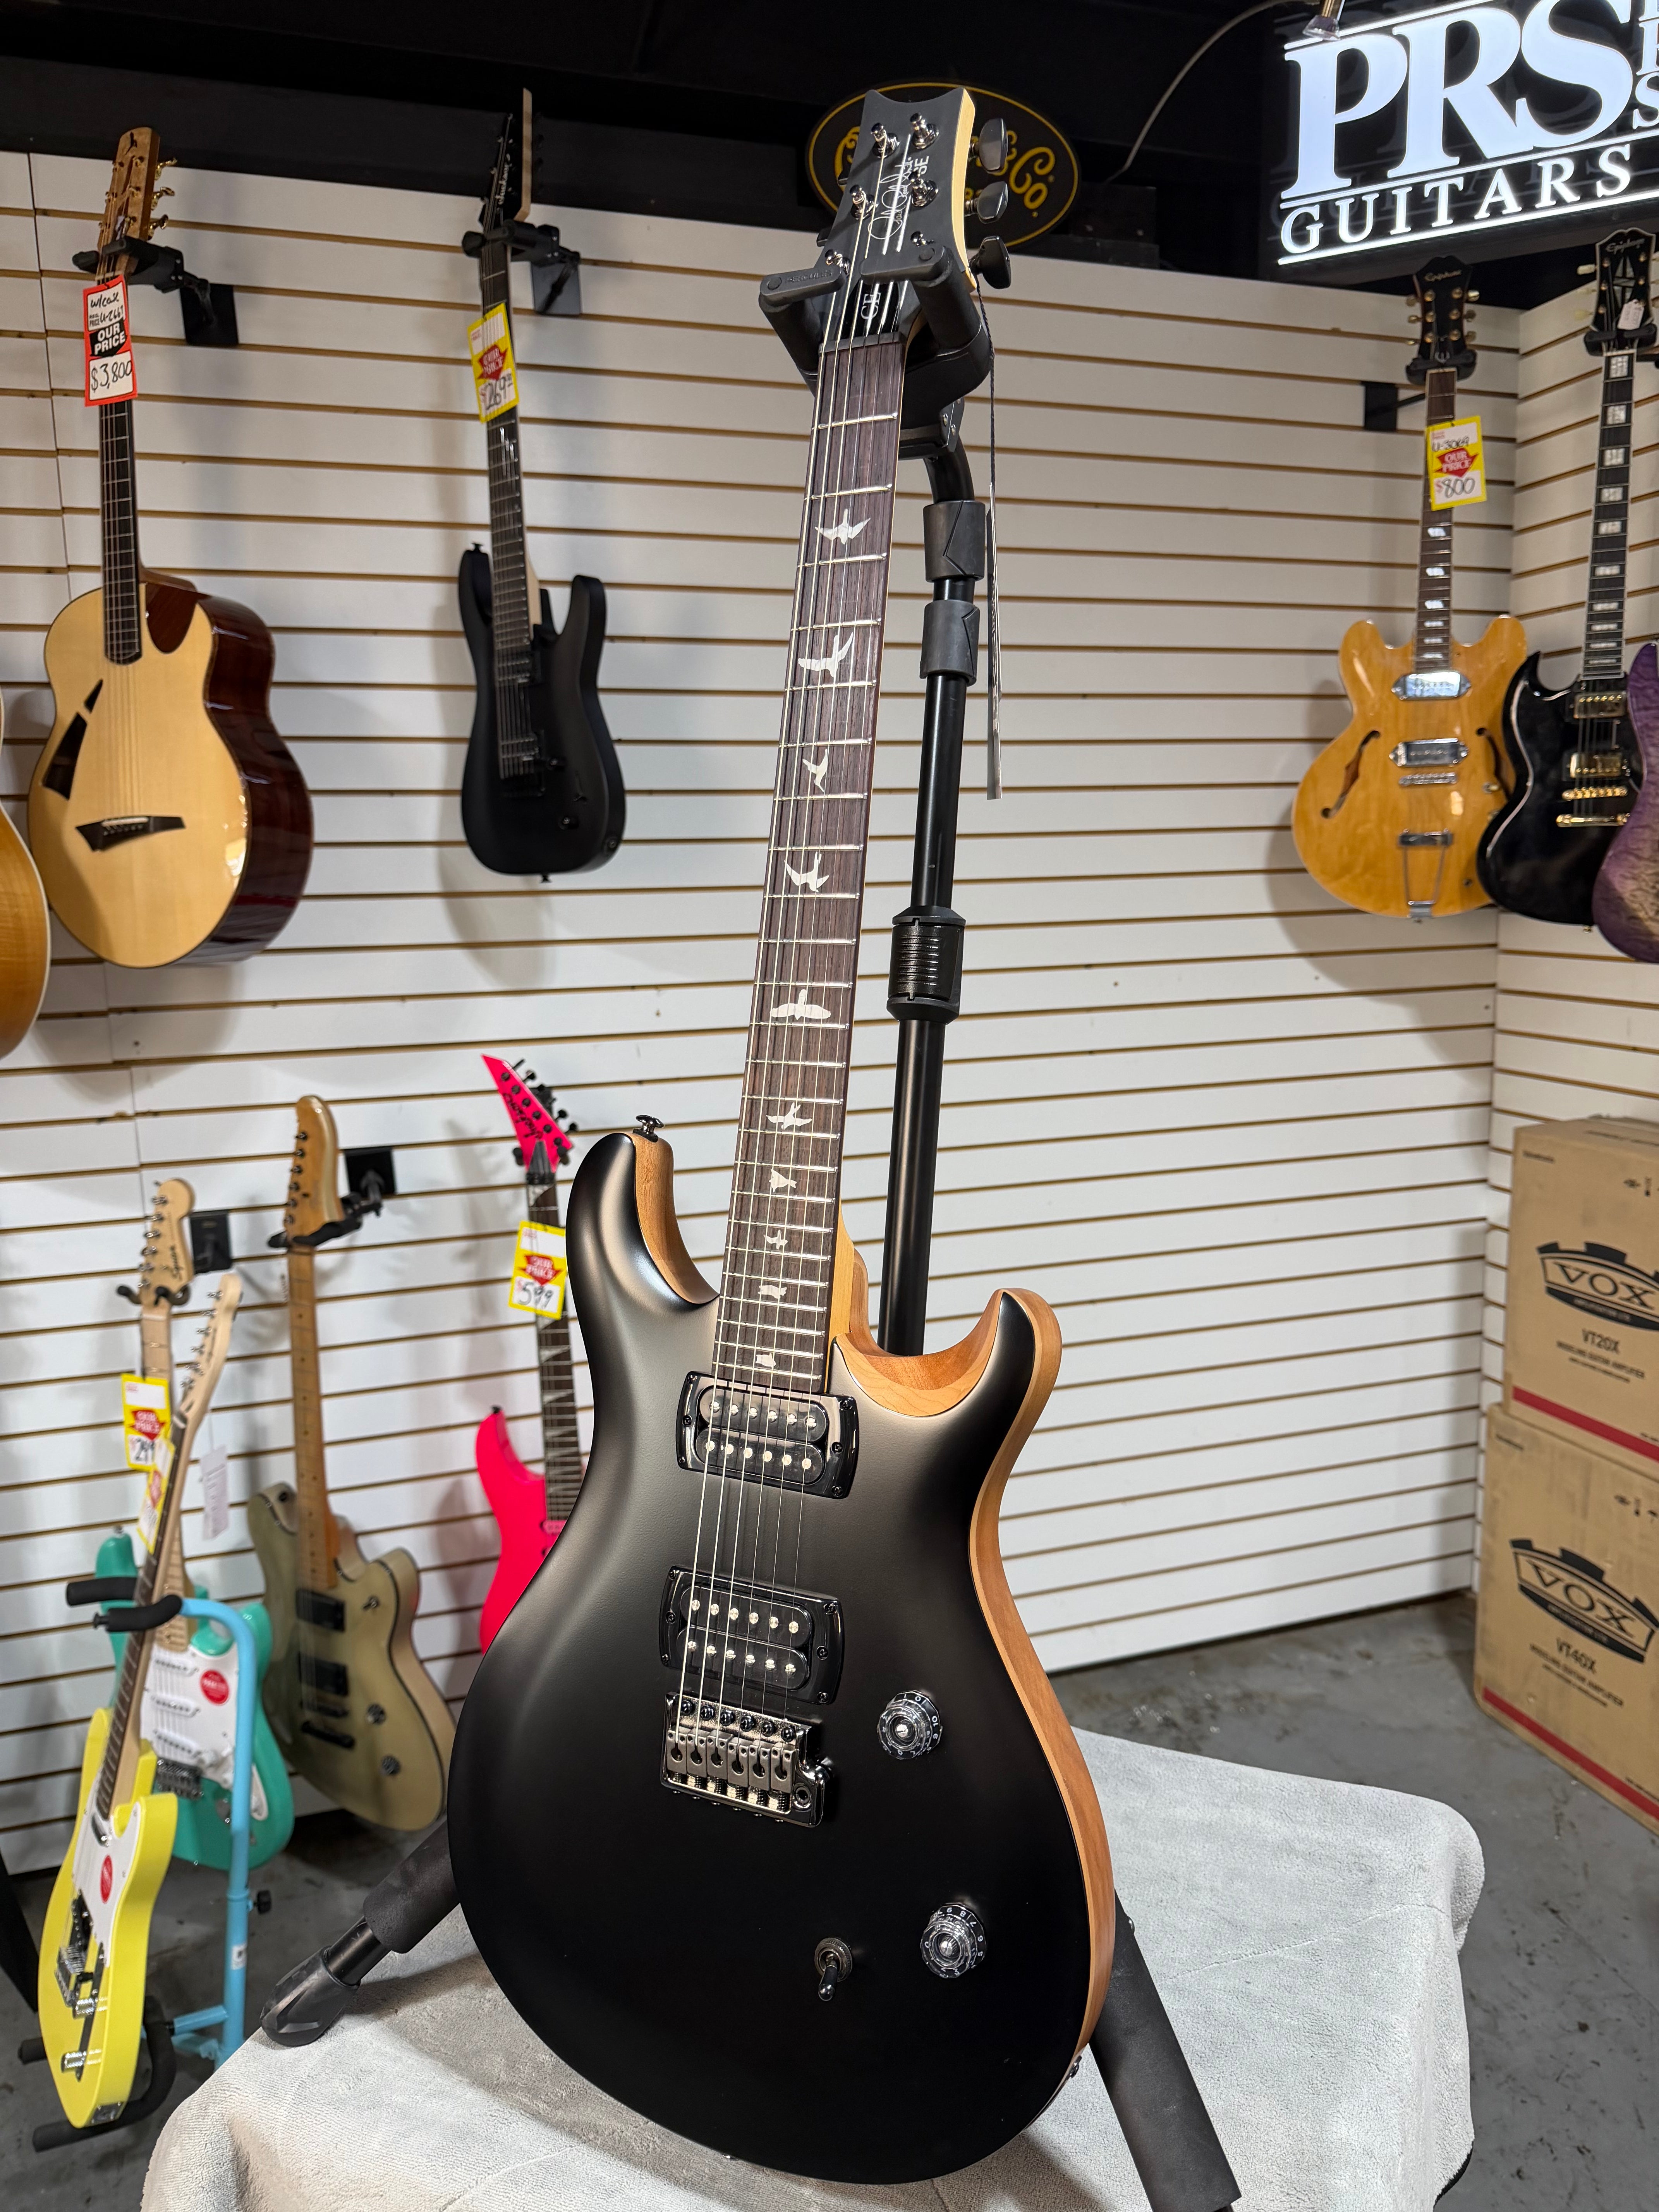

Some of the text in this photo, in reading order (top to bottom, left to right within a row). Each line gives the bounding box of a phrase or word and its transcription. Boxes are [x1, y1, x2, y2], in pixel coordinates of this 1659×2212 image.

[1281, 0, 1633, 199] PRS
[1279, 143, 1631, 255] GUITARS
[860, 292, 881, 320] CE
[94, 331, 126, 356] PRICE
[97, 322, 120, 342] OUR
[91, 360, 132, 393] $3,800
[1442, 460, 1472, 473] PRICE
[1444, 450, 1468, 463] OUR
[1441, 477, 1475, 498] 800
[1554, 1262, 1656, 1310] VOX
[1582, 1329, 1620, 1354] VT20X
[1527, 1559, 1637, 1638] VOX
